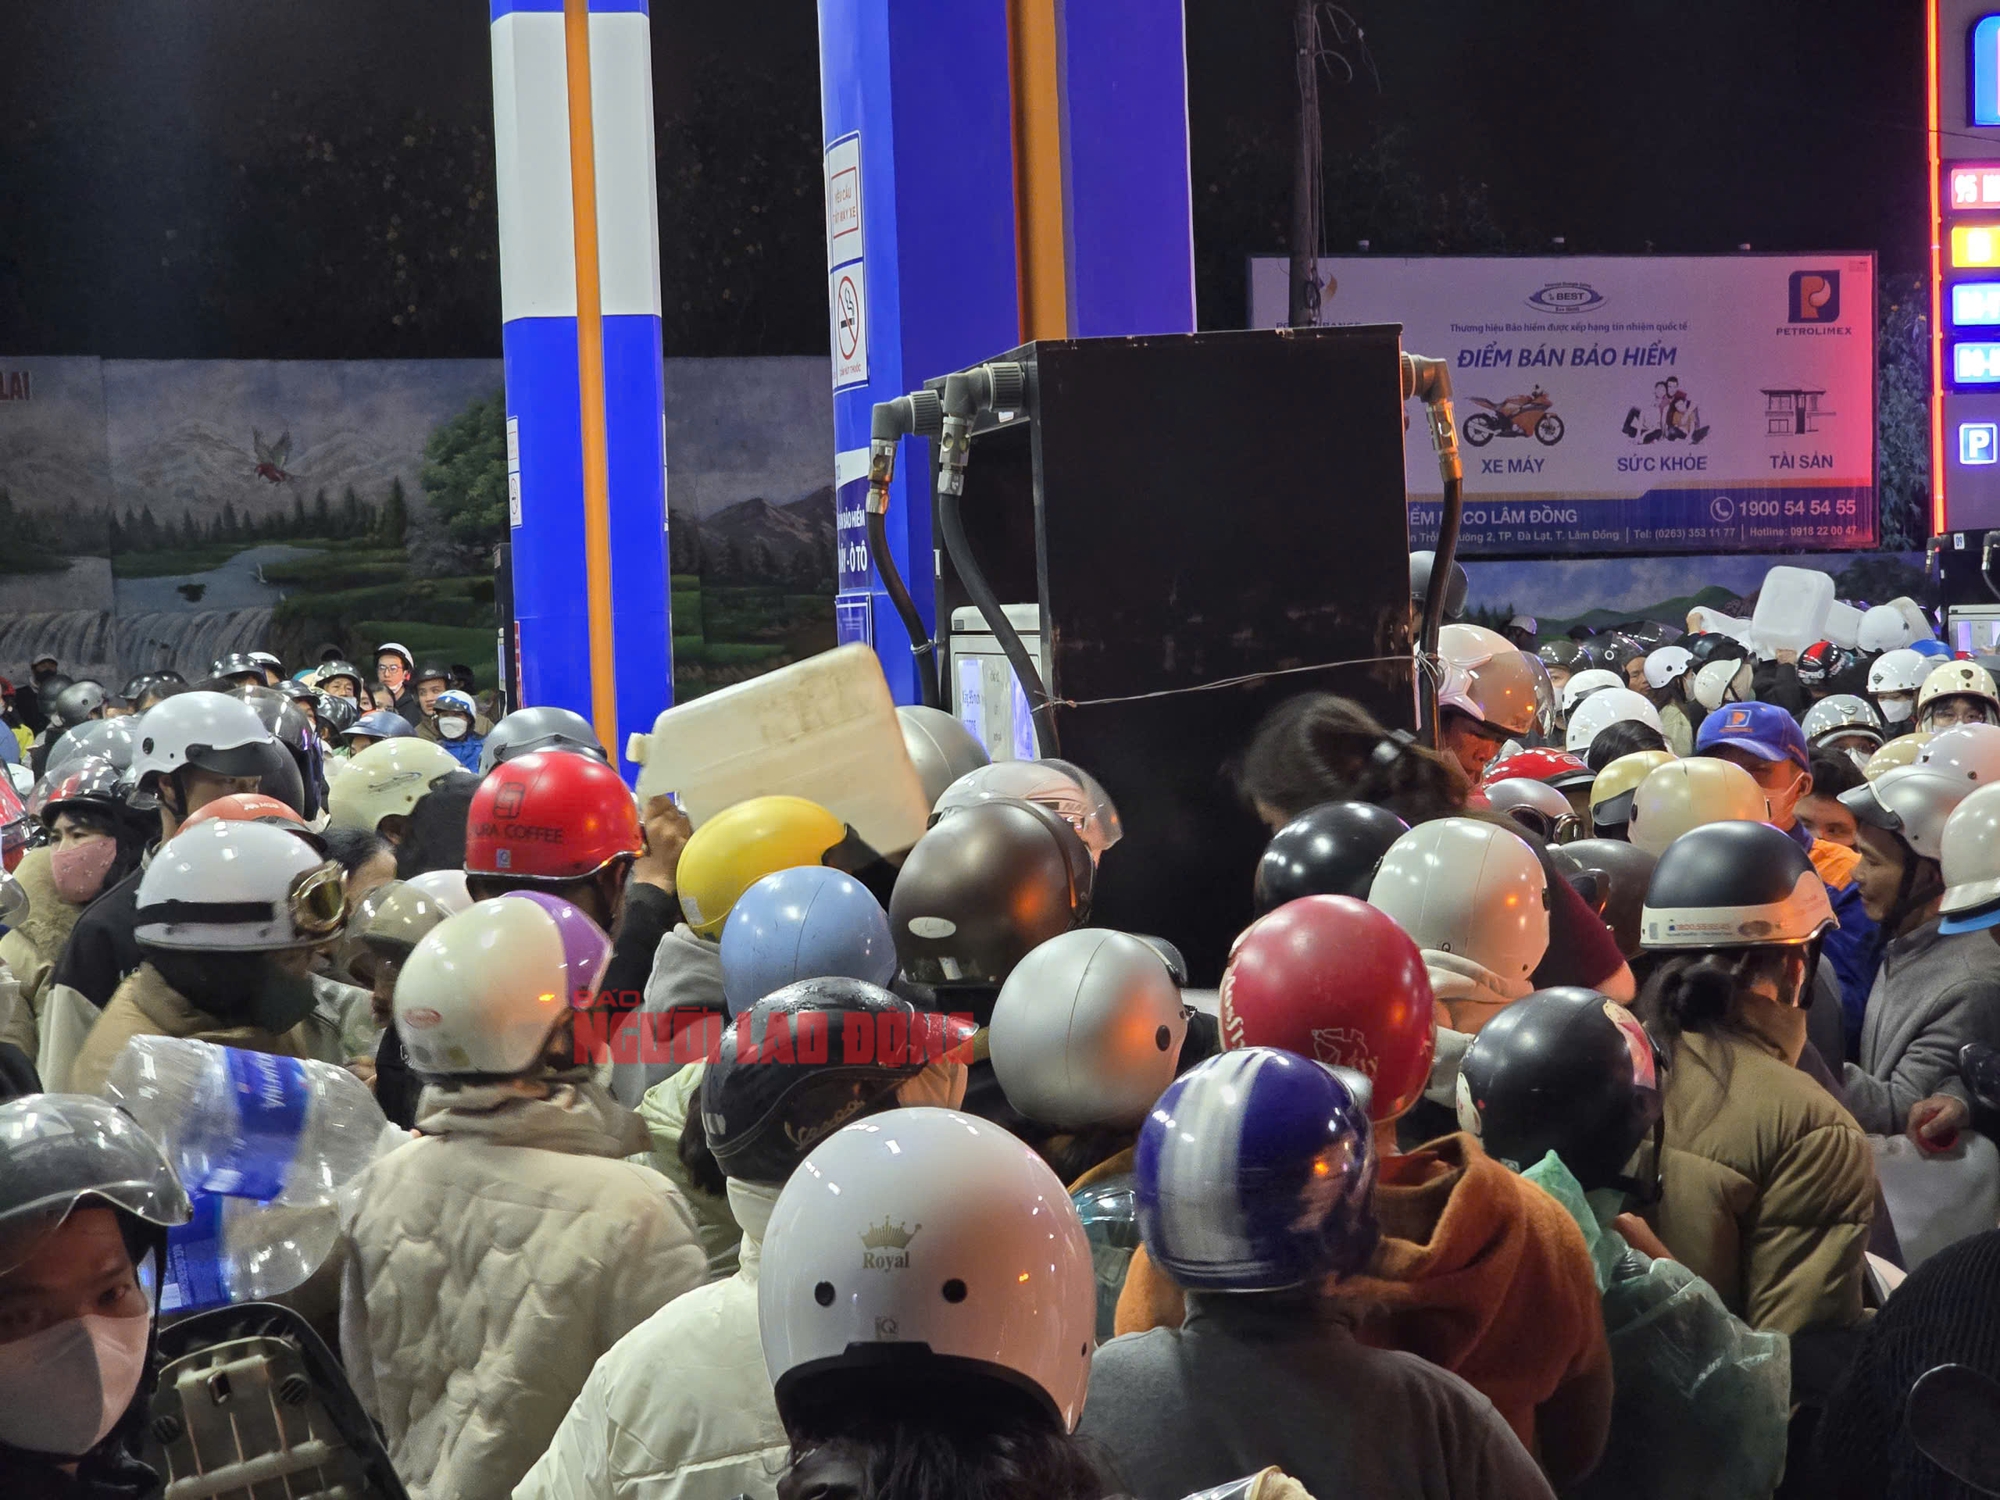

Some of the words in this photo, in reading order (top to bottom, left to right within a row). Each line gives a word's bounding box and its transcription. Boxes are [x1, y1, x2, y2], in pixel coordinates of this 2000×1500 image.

[1556, 292, 1585, 301] BEST
[1450, 323, 1484, 334] Thương
[1485, 323, 1504, 334] hiệu
[1547, 322, 1569, 334] được
[1570, 322, 1587, 333] xếp
[1588, 323, 1610, 333] hạng
[1626, 322, 1655, 332] nhiệm
[1656, 322, 1678, 333] quốc
[1678, 321, 1688, 331] tế
[1775, 326, 1852, 336] PETROLIMEX
[1457, 340, 1513, 368] ĐIỂM
[1517, 342, 1566, 368] BÁN
[1570, 342, 1617, 367] BẢO
[1622, 339, 1678, 366] HIỂM
[1481, 459, 1503, 474] XE
[1507, 455, 1545, 473] MÁY
[1617, 453, 1656, 472] SỨC
[1660, 452, 1708, 471] KHỎE
[1770, 451, 1795, 469] TÀI
[1798, 451, 1834, 469] SẢN
[1410, 505, 1435, 525] ỂM
[1491, 506, 1525, 524] LÂM
[1529, 504, 1578, 523] ĐỒNG
[1739, 500, 1779, 516] 1900
[1784, 500, 1805, 515] 54
[1810, 500, 1831, 515] 54
[1836, 499, 1857, 515] 55
[1498, 531, 1514, 541] TP.
[1517, 531, 1531, 541] Đà
[1568, 530, 1590, 540] Lâm
[1592, 529, 1620, 541] Đồng
[1633, 529, 1652, 539] Tel:
[1655, 528, 1686, 540] (0263)
[1709, 528, 1721, 537] 11
[1723, 528, 1736, 537] 77
[1750, 526, 1788, 537] Hotline:
[1790, 526, 1814, 536] 0918
[1817, 526, 1829, 536] 22
[1830, 525, 1843, 535] 00
[1845, 525, 1857, 535] 47
[504, 823, 564, 844] COFFEE
[862, 1252, 910, 1273] Royal
